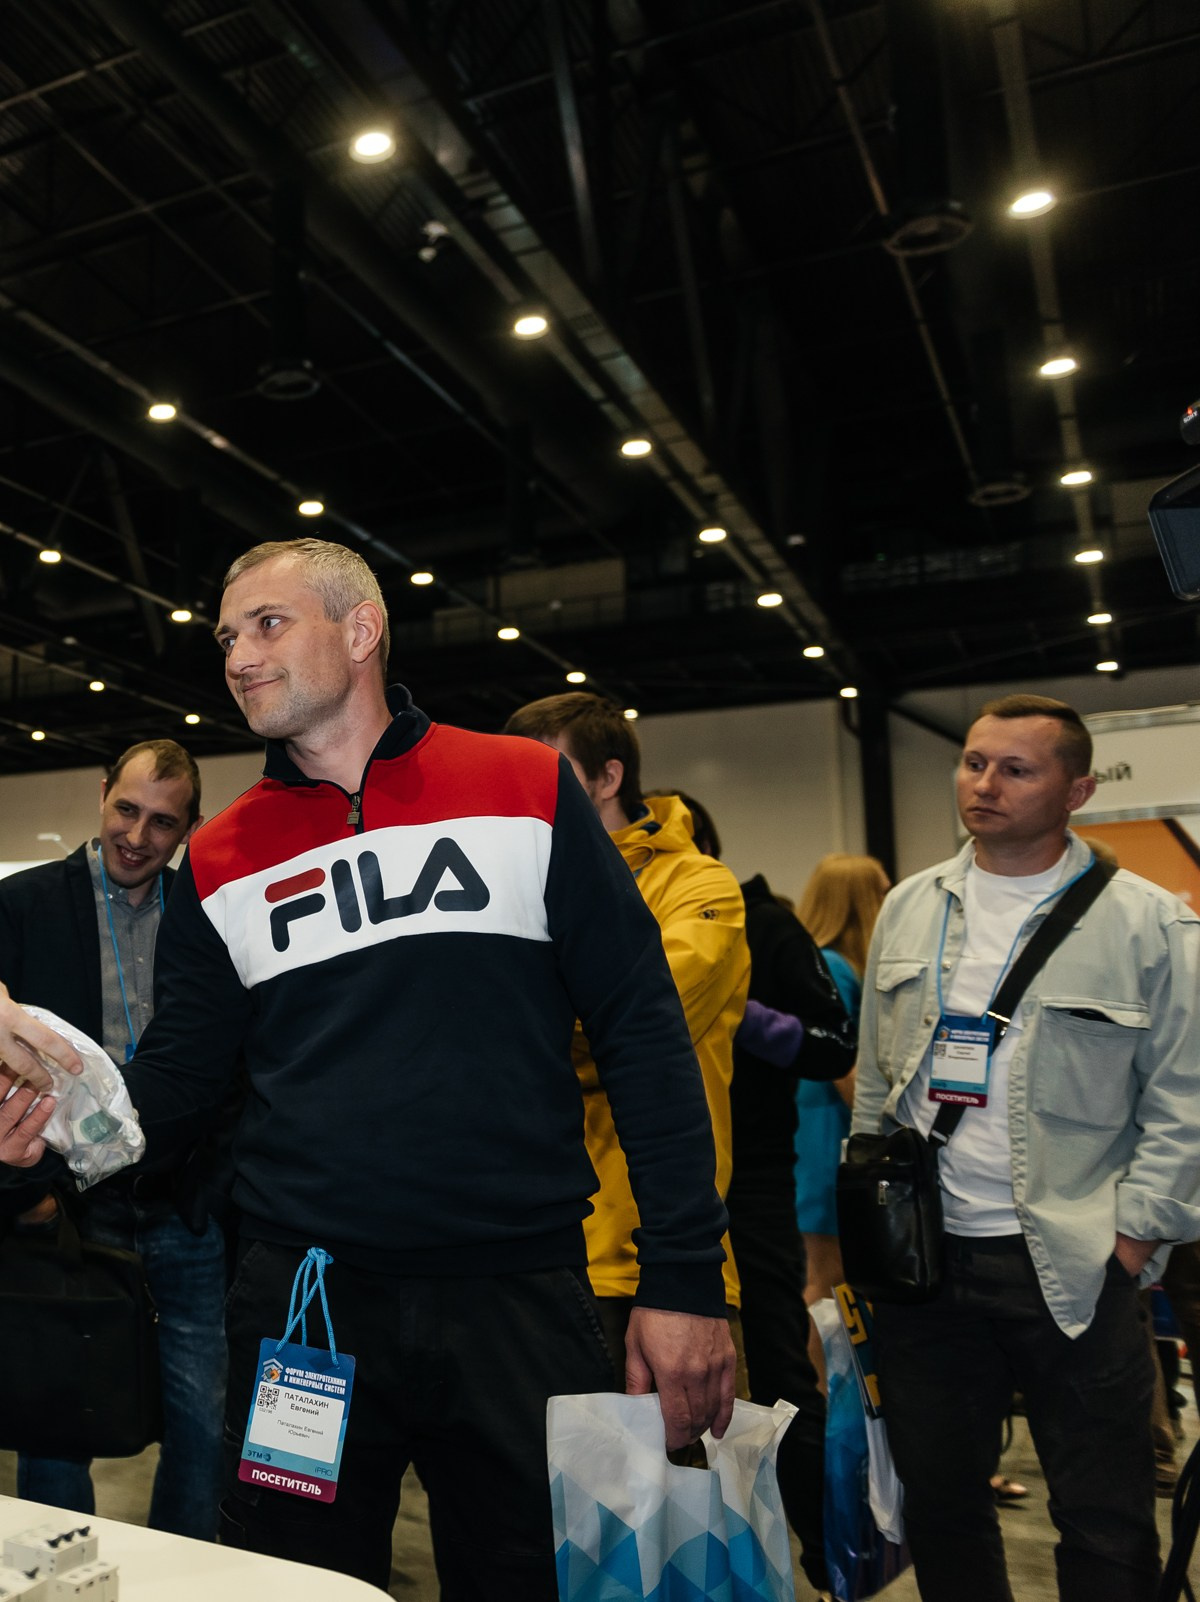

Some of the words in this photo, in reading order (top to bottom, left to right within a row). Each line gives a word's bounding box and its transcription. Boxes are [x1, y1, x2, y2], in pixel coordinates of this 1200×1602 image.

[264, 837, 490, 953] FILA
[285, 1367, 304, 1377] ФОРУМ
[305, 1371, 346, 1387] ЭЛЕКТРОТЕХНИКИ
[289, 1376, 324, 1390] ИНЖЕНЕРНЫХ
[324, 1384, 345, 1395] СИСТЕМ
[284, 1392, 329, 1409] ПАТАЛАХИН
[290, 1403, 319, 1416] Евгений
[277, 1419, 303, 1429] Паталахин
[304, 1426, 323, 1435] Евгений
[288, 1430, 310, 1439] Юрьевич
[248, 1450, 262, 1459] ЭТМ
[251, 1469, 321, 1495] ПОСЕТИТЕЛЬ
